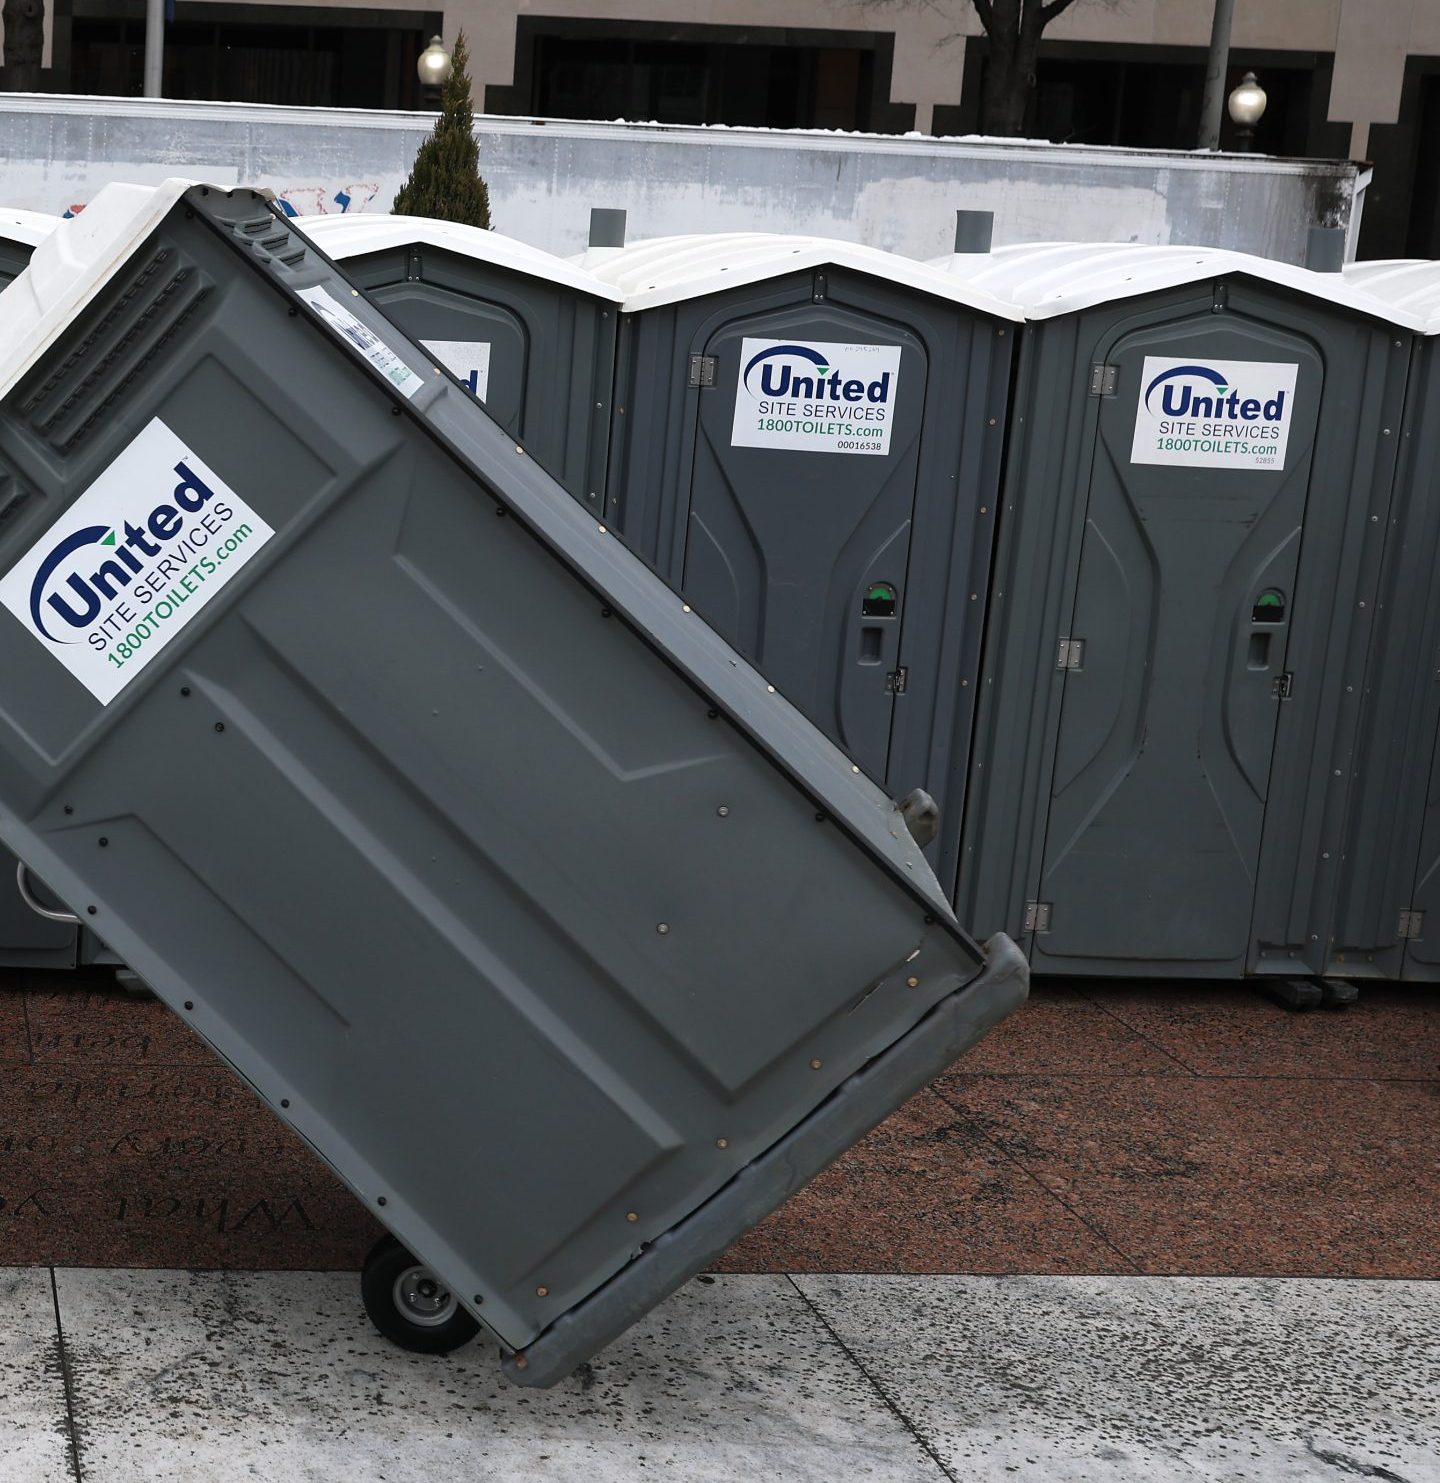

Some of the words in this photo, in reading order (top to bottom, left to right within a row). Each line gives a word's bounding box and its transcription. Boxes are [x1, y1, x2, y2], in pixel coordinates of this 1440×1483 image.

[761, 363, 890, 403] United
[758, 401, 797, 416] SITE
[803, 403, 885, 421] SERVICES
[1162, 384, 1285, 421] United
[757, 418, 883, 437] 1800TOILETS.com
[838, 441, 882, 450] 00016538
[1159, 421, 1196, 435] SITE
[1201, 424, 1279, 439] SERVICES
[1156, 438, 1277, 455] 1800TOILETS.com
[46, 461, 214, 628] United
[88, 602, 137, 651] SITE
[134, 502, 233, 605] SERVICES
[108, 521, 253, 669] 1800TOILETS.com
[116, 1196, 315, 1234] What
